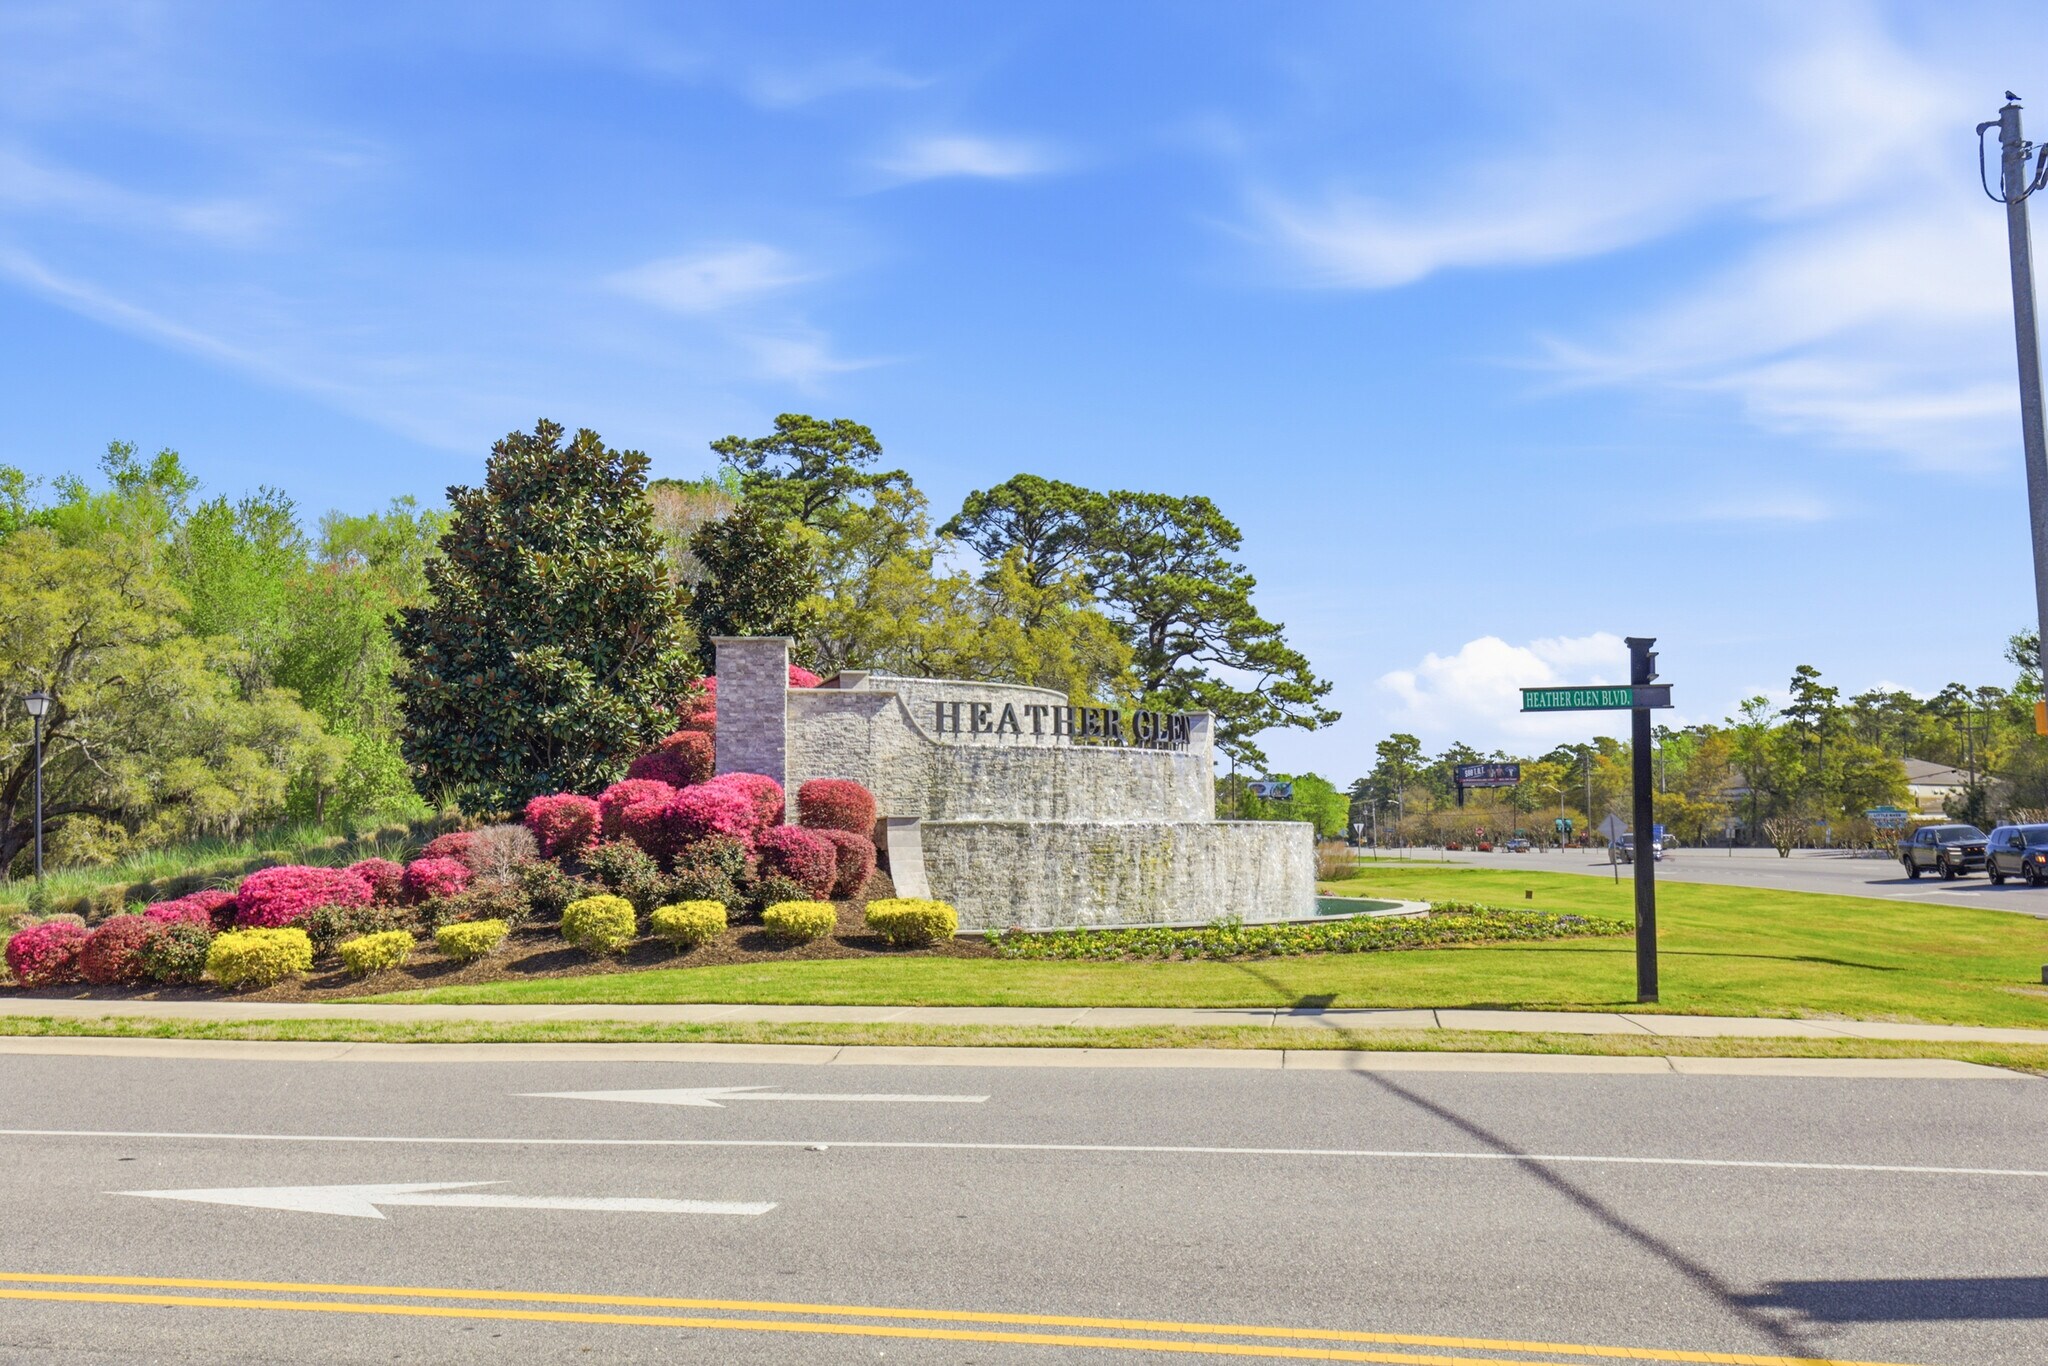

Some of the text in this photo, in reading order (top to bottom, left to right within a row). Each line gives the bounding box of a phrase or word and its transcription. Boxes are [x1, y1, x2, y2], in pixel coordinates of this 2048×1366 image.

[1526, 689, 1630, 708] HEATHER GLEN BLVD.
[932, 700, 1193, 744] HEATHER GLEN
